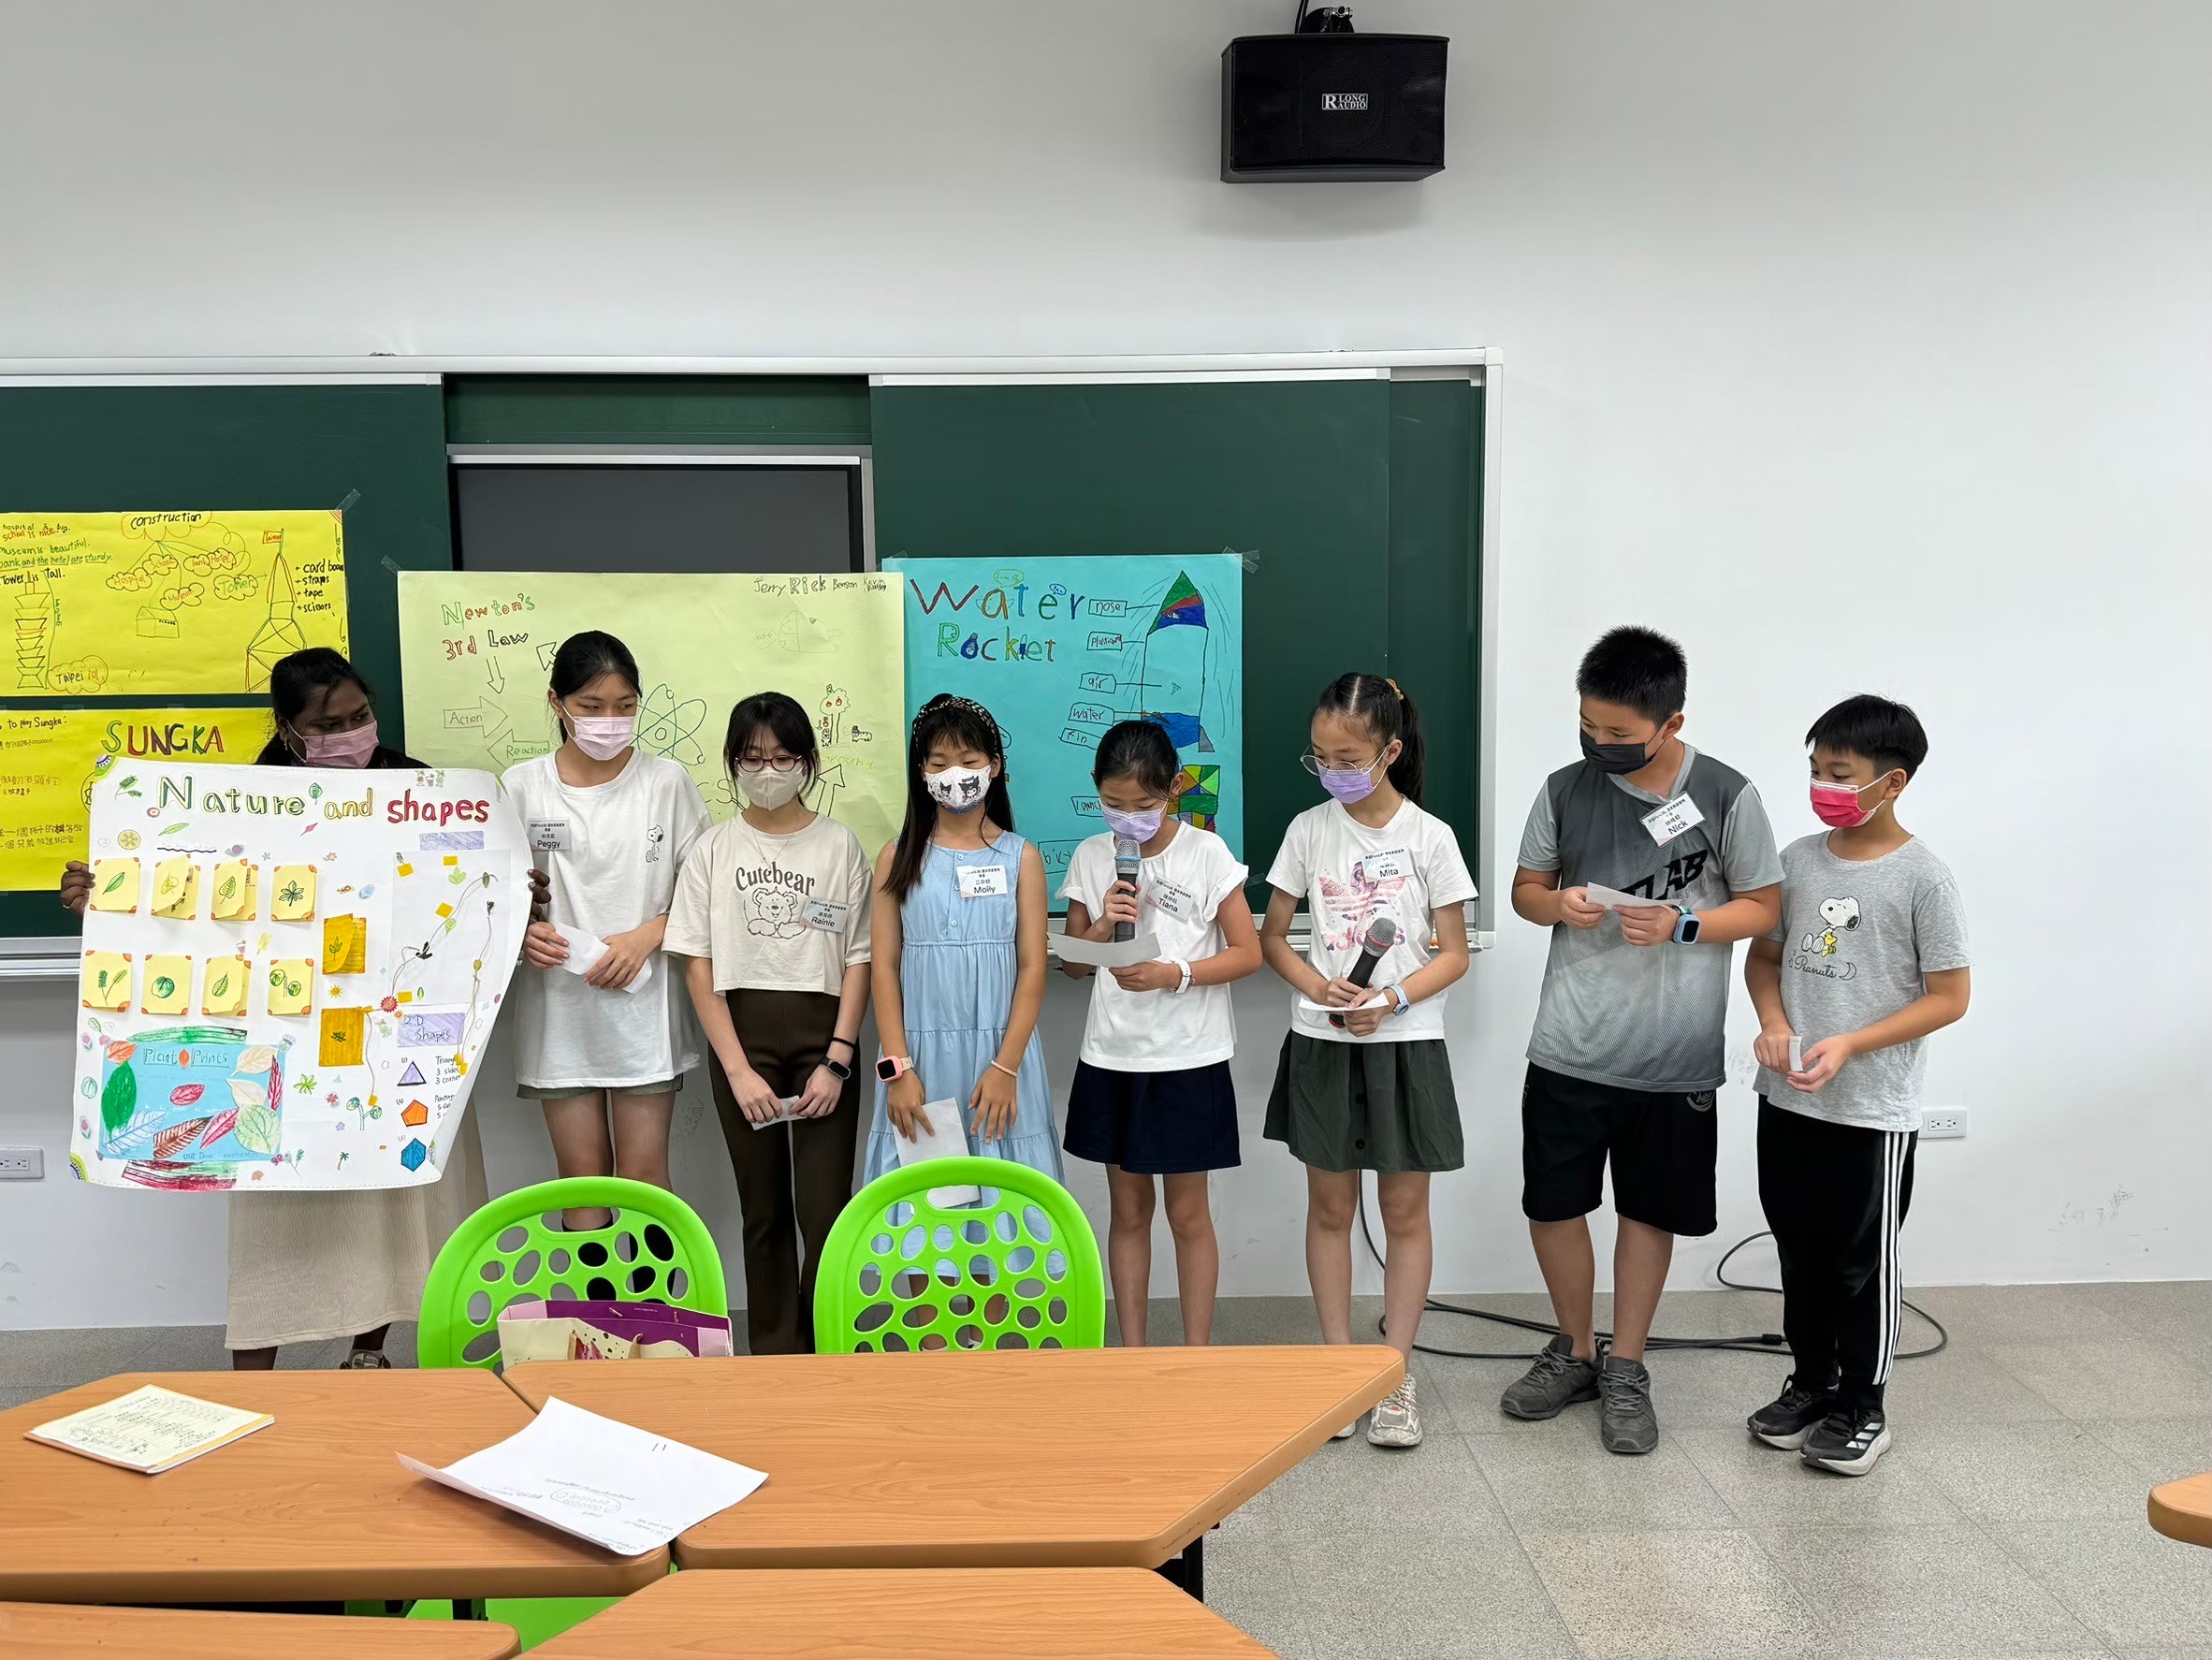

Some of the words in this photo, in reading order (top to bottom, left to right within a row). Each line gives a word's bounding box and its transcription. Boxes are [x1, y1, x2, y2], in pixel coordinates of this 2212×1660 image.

[1338, 101, 1366, 109] AUDIO
[36, 556, 49, 564] the
[753, 576, 786, 596] Jerry
[790, 575, 825, 594] Rick
[304, 588, 324, 600] tape
[910, 578, 1085, 620] Water
[442, 593, 535, 628] Newton's
[1096, 602, 1121, 615] nose
[443, 635, 477, 661] 3rd
[488, 630, 529, 648] Law
[938, 622, 1056, 662] Rocket
[1087, 676, 1108, 689] air
[449, 711, 482, 725] Action
[101, 720, 224, 756] SUNGKA
[506, 745, 548, 758] Reaction
[159, 775, 306, 817] Nature
[324, 787, 373, 820] and
[387, 788, 489, 826] shapes
[1667, 820, 1688, 835] Nick
[537, 840, 560, 850] Peggy
[735, 861, 815, 896] Cutebear
[1379, 868, 1399, 878] Mita
[1158, 897, 1178, 912] Tiana
[1795, 955, 1837, 978] Peanuts
